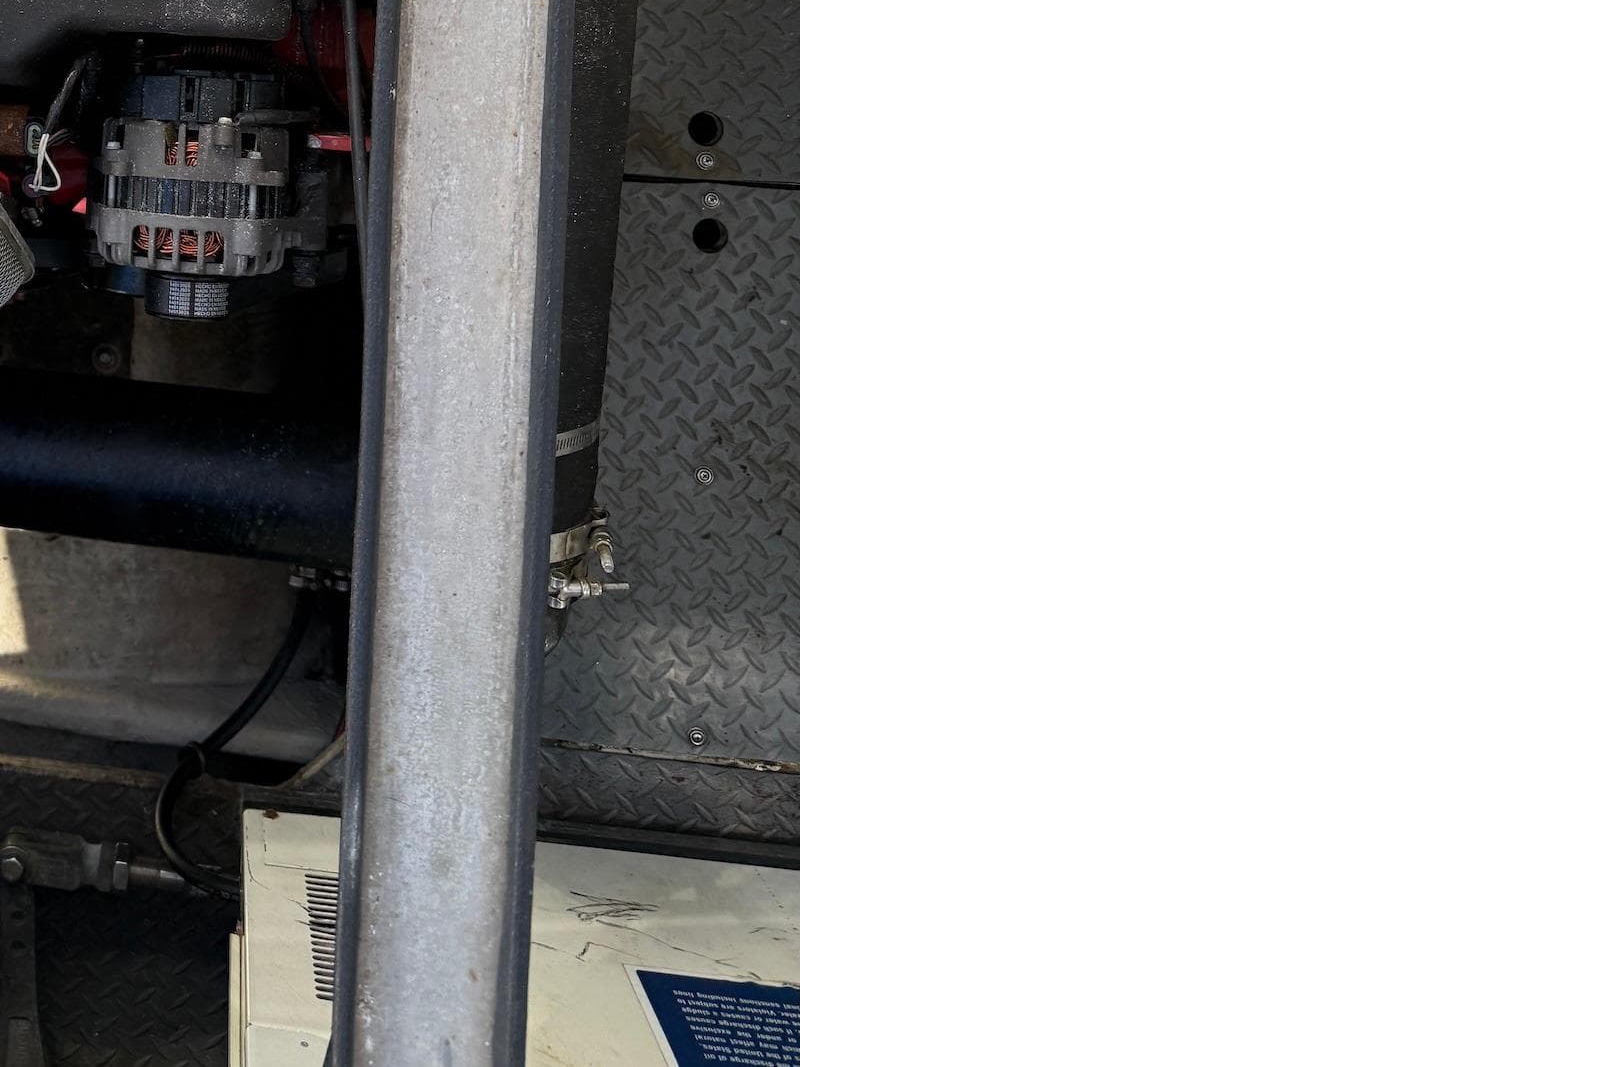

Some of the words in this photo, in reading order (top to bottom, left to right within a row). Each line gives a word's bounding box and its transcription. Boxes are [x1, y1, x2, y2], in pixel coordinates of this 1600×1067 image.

[673, 990, 694, 998] fines
[696, 992, 737, 1002] including
[688, 999, 719, 1008] subject
[739, 998, 779, 1008] sanctions
[682, 1007, 710, 1015] sludge
[737, 1006, 776, 1016] Violators
[686, 1016, 716, 1024] causes
[690, 1025, 731, 1034] exclusive
[718, 1020, 761, 1030] discharge
[733, 1048, 764, 1057] United
